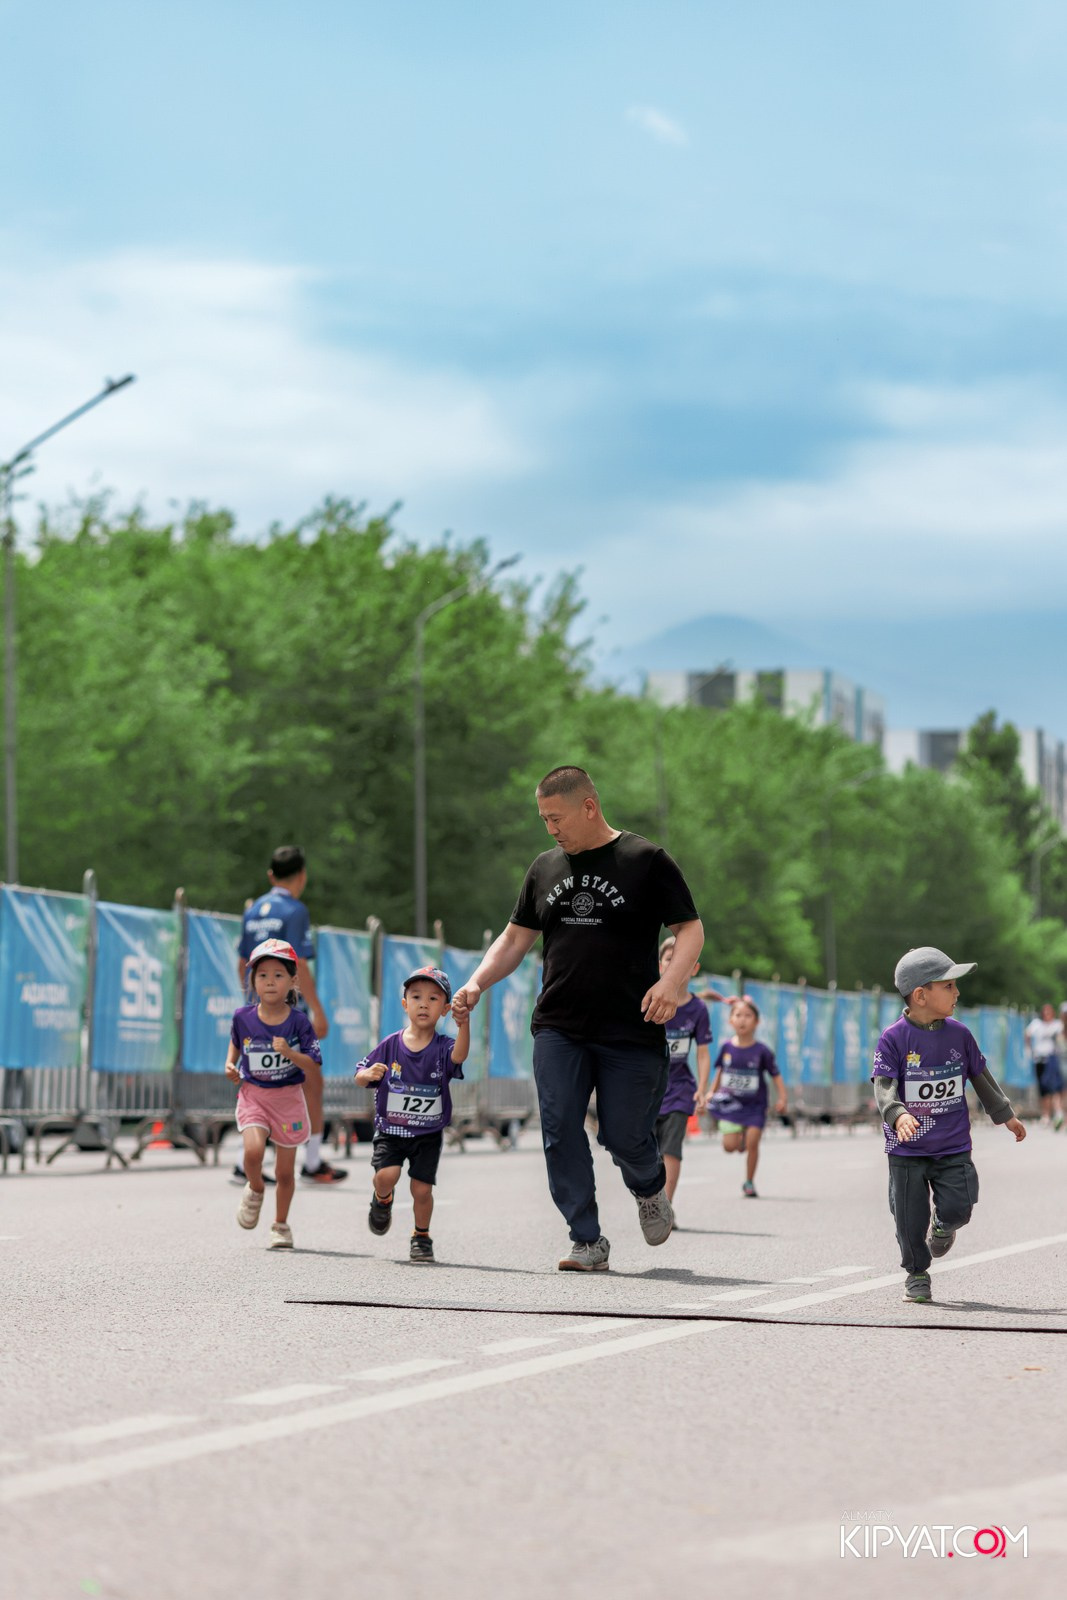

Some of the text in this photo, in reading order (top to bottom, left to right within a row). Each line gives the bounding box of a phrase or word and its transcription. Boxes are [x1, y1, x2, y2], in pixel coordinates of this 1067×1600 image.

[546, 876, 574, 906] NEW
[581, 875, 625, 907] STATE
[668, 1041, 680, 1052] 6
[879, 1063, 892, 1072] City
[918, 1079, 956, 1100] 092
[402, 1097, 436, 1114] 127
